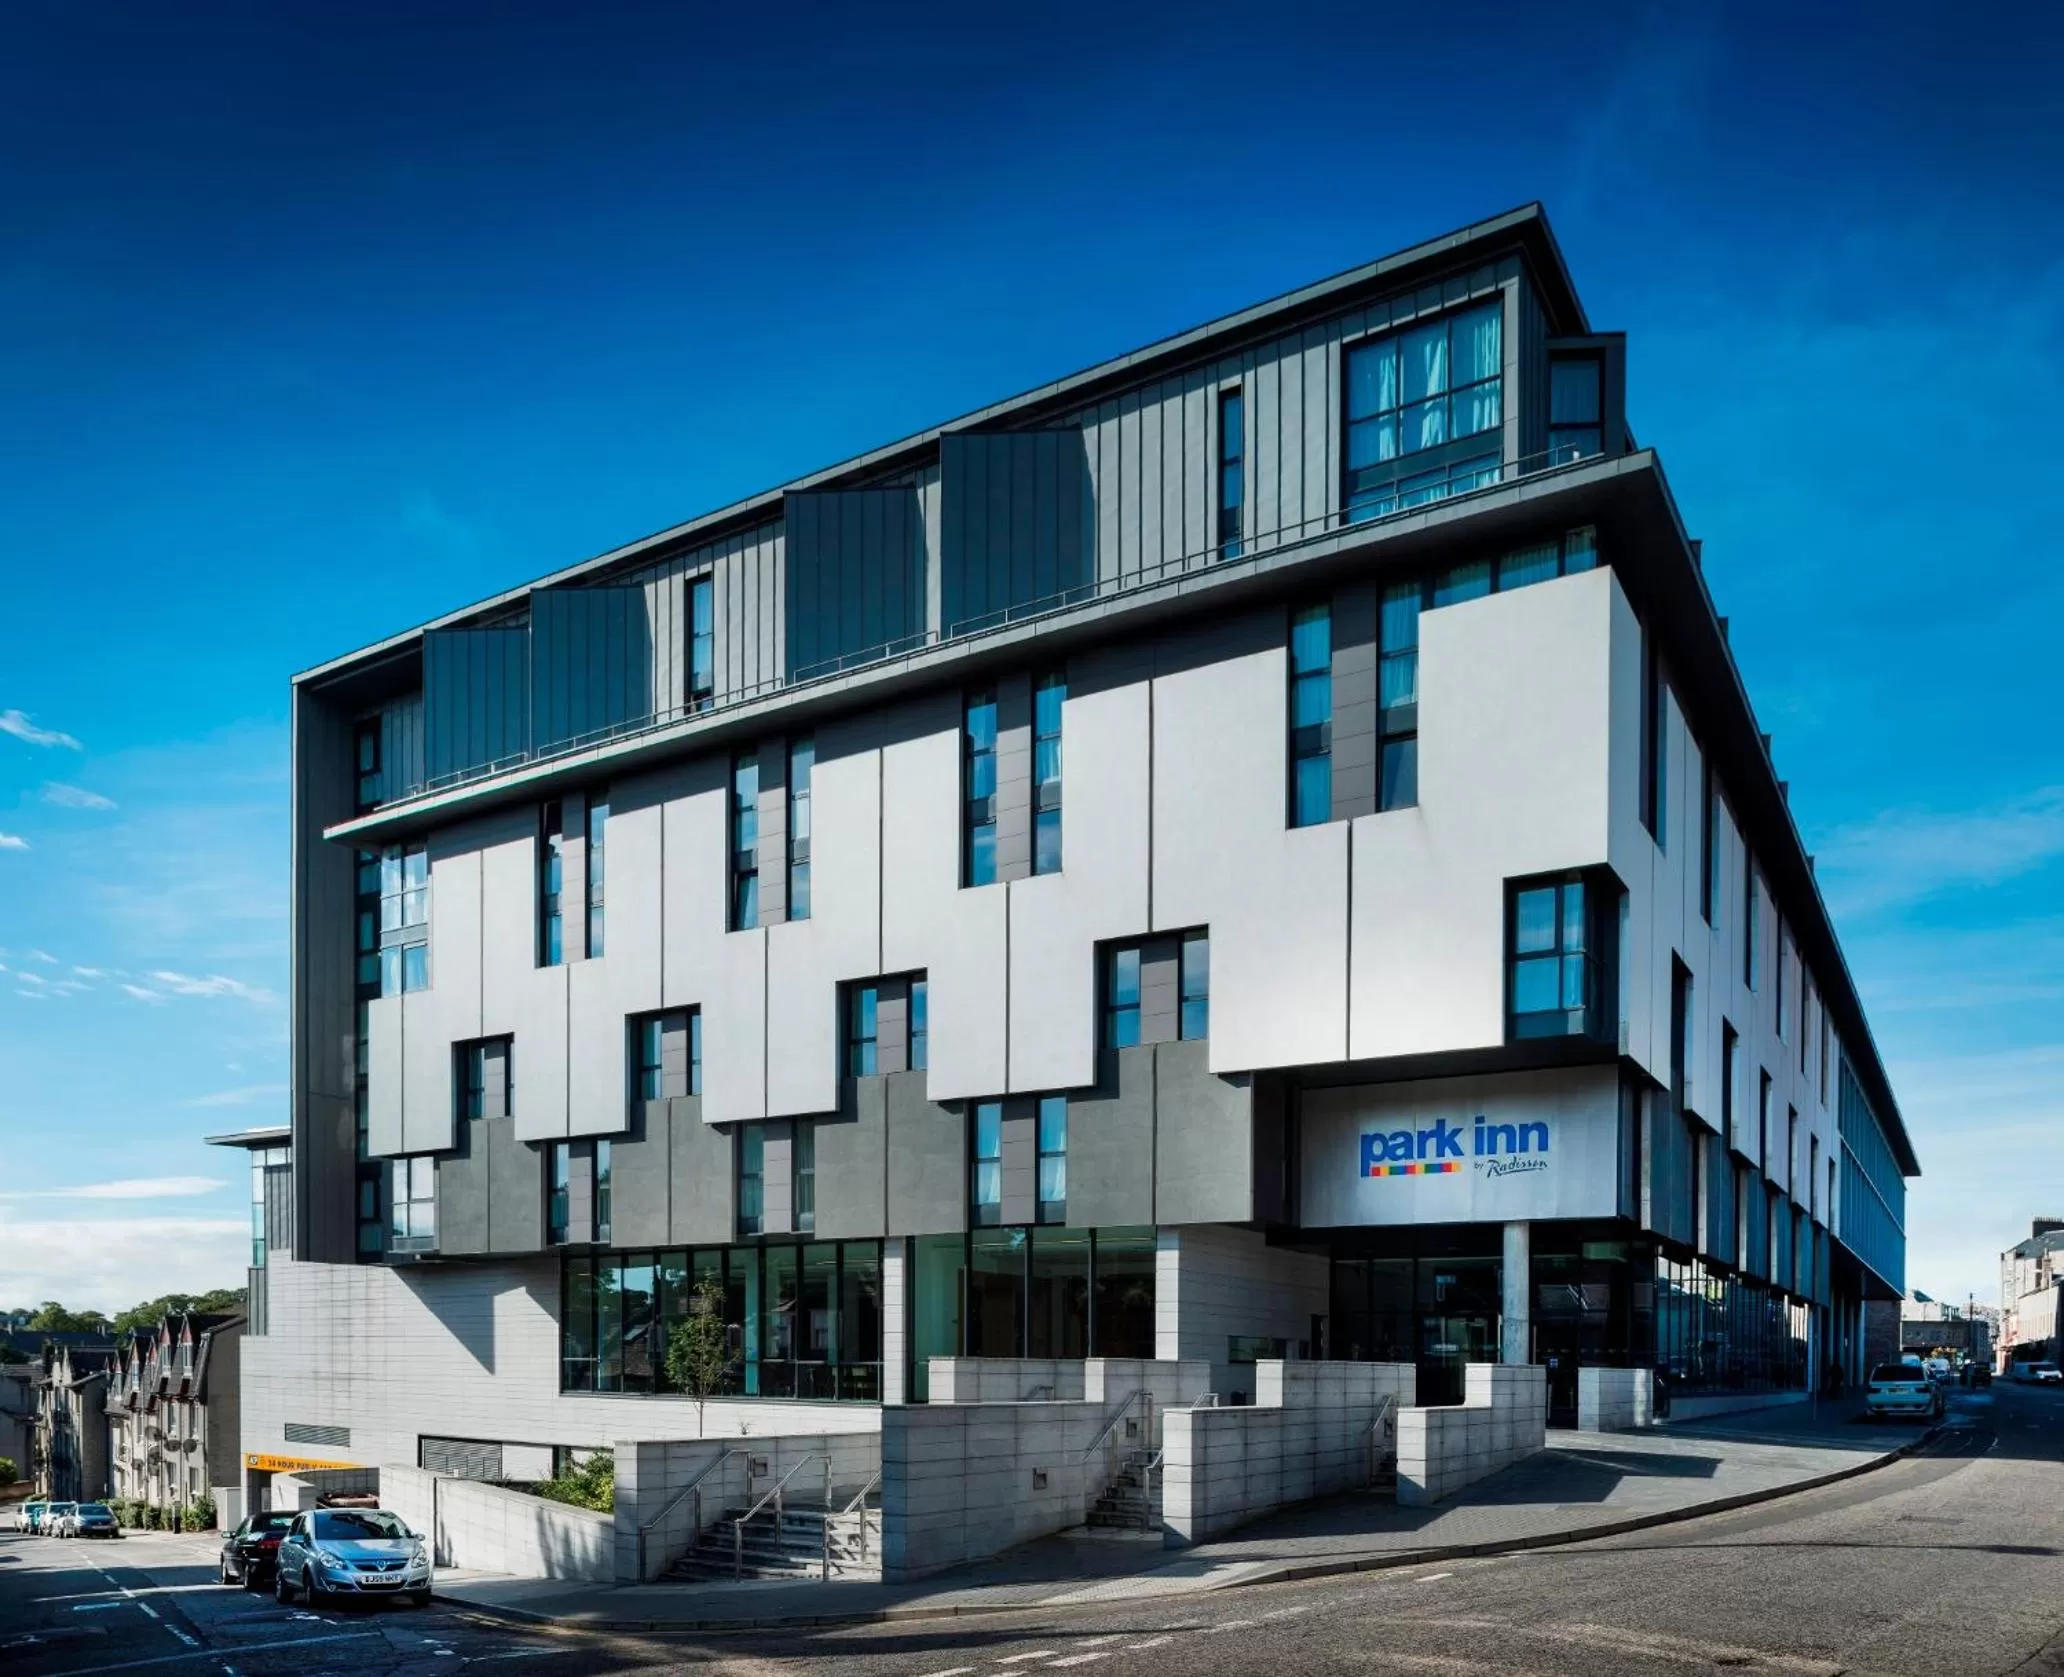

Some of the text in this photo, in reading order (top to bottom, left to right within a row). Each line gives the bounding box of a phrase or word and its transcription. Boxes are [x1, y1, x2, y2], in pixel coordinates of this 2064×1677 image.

[1360, 1116, 1549, 1178] park inn
[1474, 1156, 1548, 1178] by Radisson
